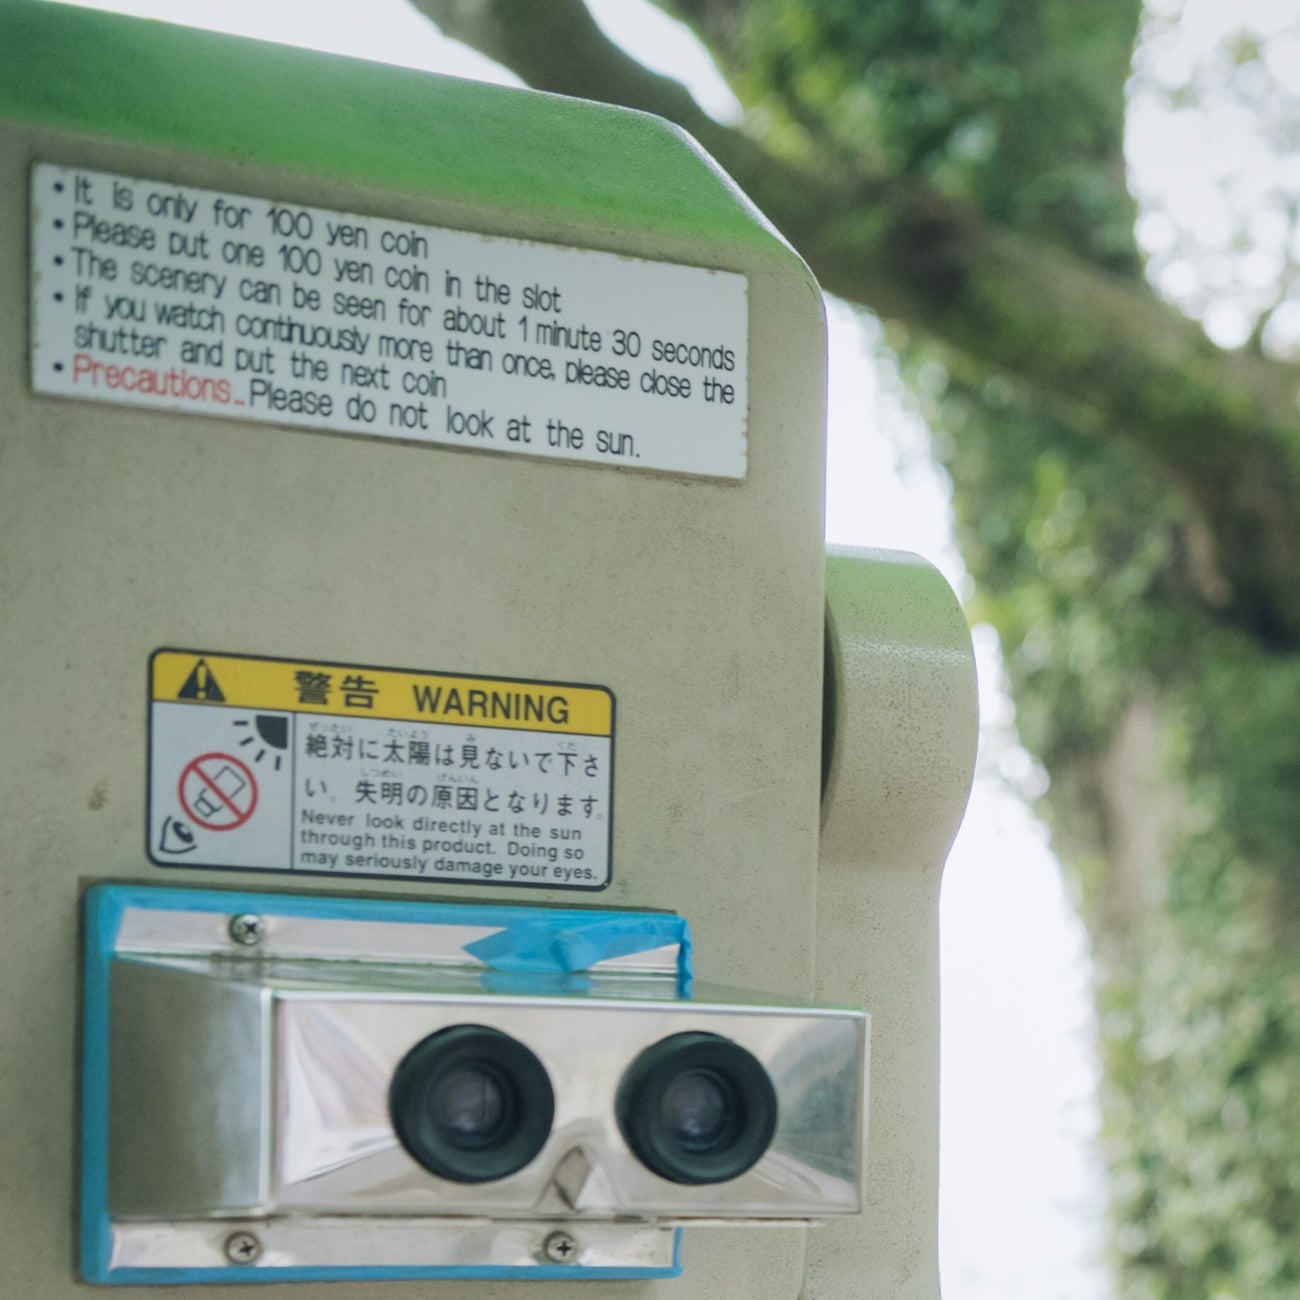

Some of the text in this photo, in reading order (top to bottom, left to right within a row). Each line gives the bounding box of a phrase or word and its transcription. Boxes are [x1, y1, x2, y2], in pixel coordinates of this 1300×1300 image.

[75, 175, 428, 258] It is only for 100 yen coin
[73, 212, 156, 251] Please
[222, 241, 264, 268] one
[279, 245, 321, 277] 100
[334, 255, 374, 288] yen
[385, 265, 429, 294] coin
[445, 270, 461, 299] in
[475, 274, 510, 306] the
[523, 284, 562, 314] slot
[71, 247, 735, 372] The scenery can be seen for about 1 minute 30 seconds
[75, 284, 735, 405] If you watch continuously more than once, please close the
[74, 323, 168, 358] shutter
[181, 340, 223, 368] and
[291, 354, 328, 382] the
[341, 362, 391, 391] next
[403, 370, 447, 398] coin
[250, 379, 333, 417] Please
[347, 394, 375, 422] do
[390, 402, 429, 430] not
[446, 406, 494, 439] look
[506, 415, 532, 444] at
[547, 418, 584, 449] the
[596, 429, 641, 458] sun.
[293, 670, 570, 725] 警告 WARNING
[305, 733, 600, 778] 絶対に太陽は見ないで下さ
[301, 809, 582, 841] Never look directly at the sun
[301, 830, 584, 862] through this product. Doing so
[300, 852, 598, 882] may seriously damage your eyes.
